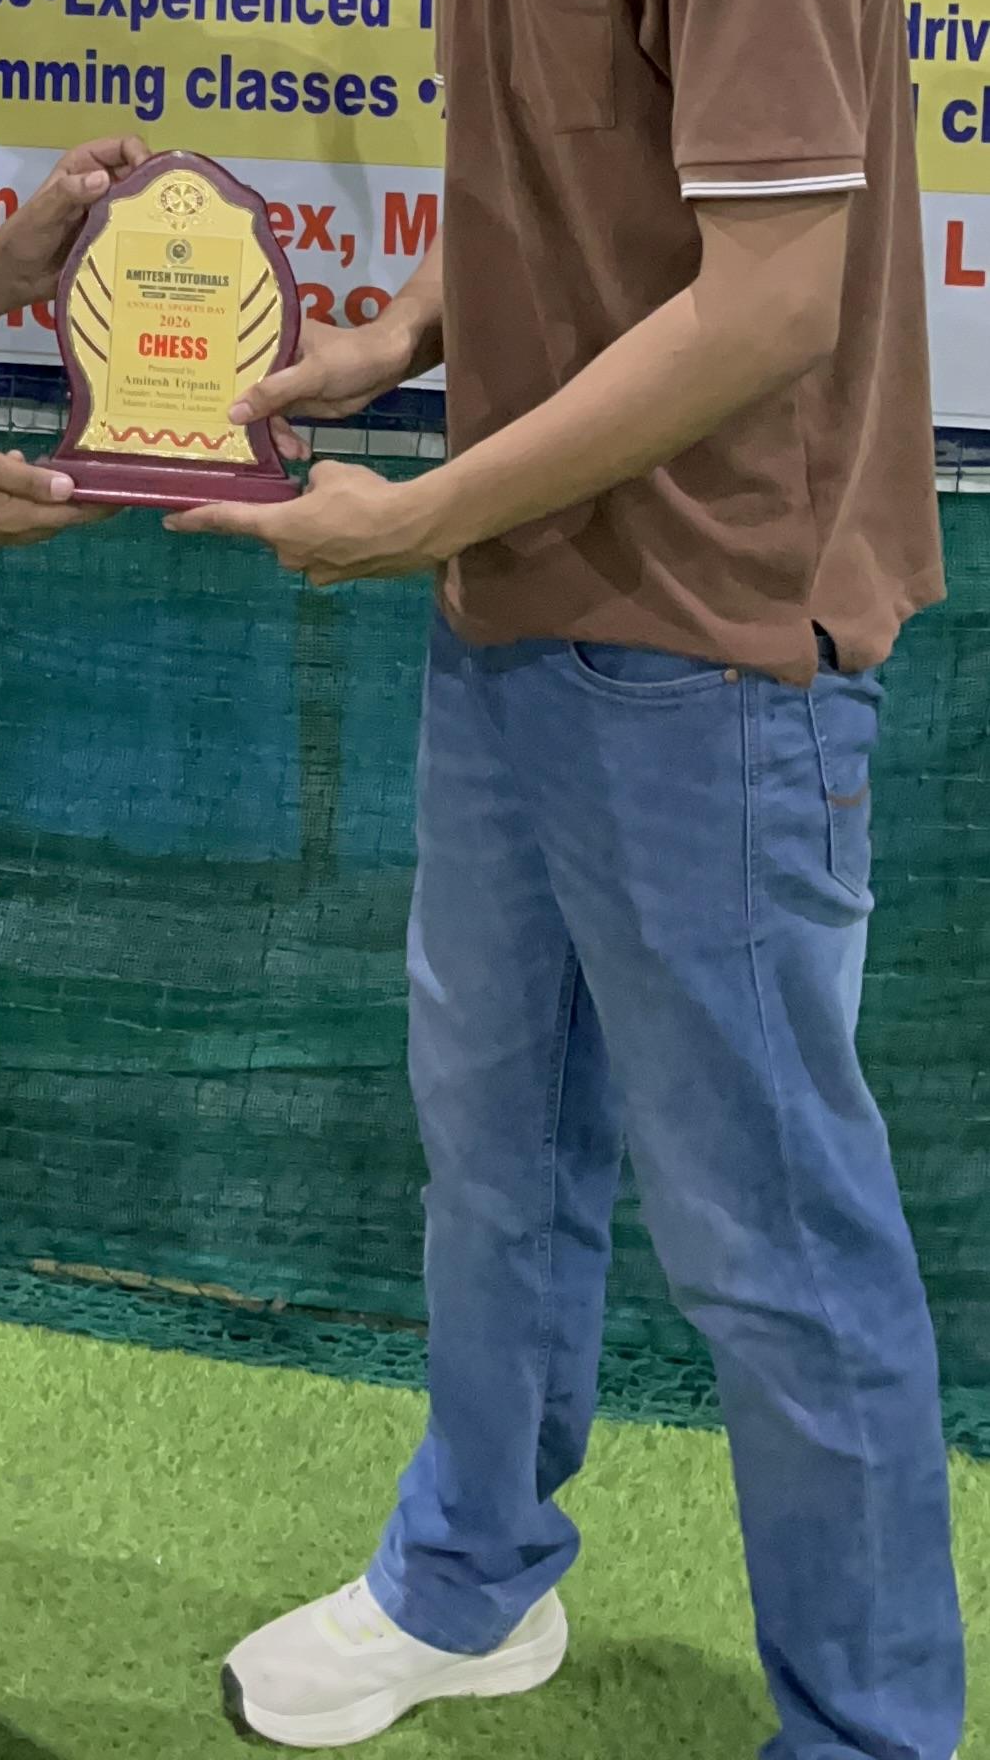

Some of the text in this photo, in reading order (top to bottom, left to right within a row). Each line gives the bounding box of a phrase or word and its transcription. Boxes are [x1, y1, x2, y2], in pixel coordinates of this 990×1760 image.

[185, 54, 399, 117] classes
[125, 269, 229, 287] AMITESH TUTORIALS
[159, 315, 191, 328] 2026
[138, 332, 208, 361] CHESS
